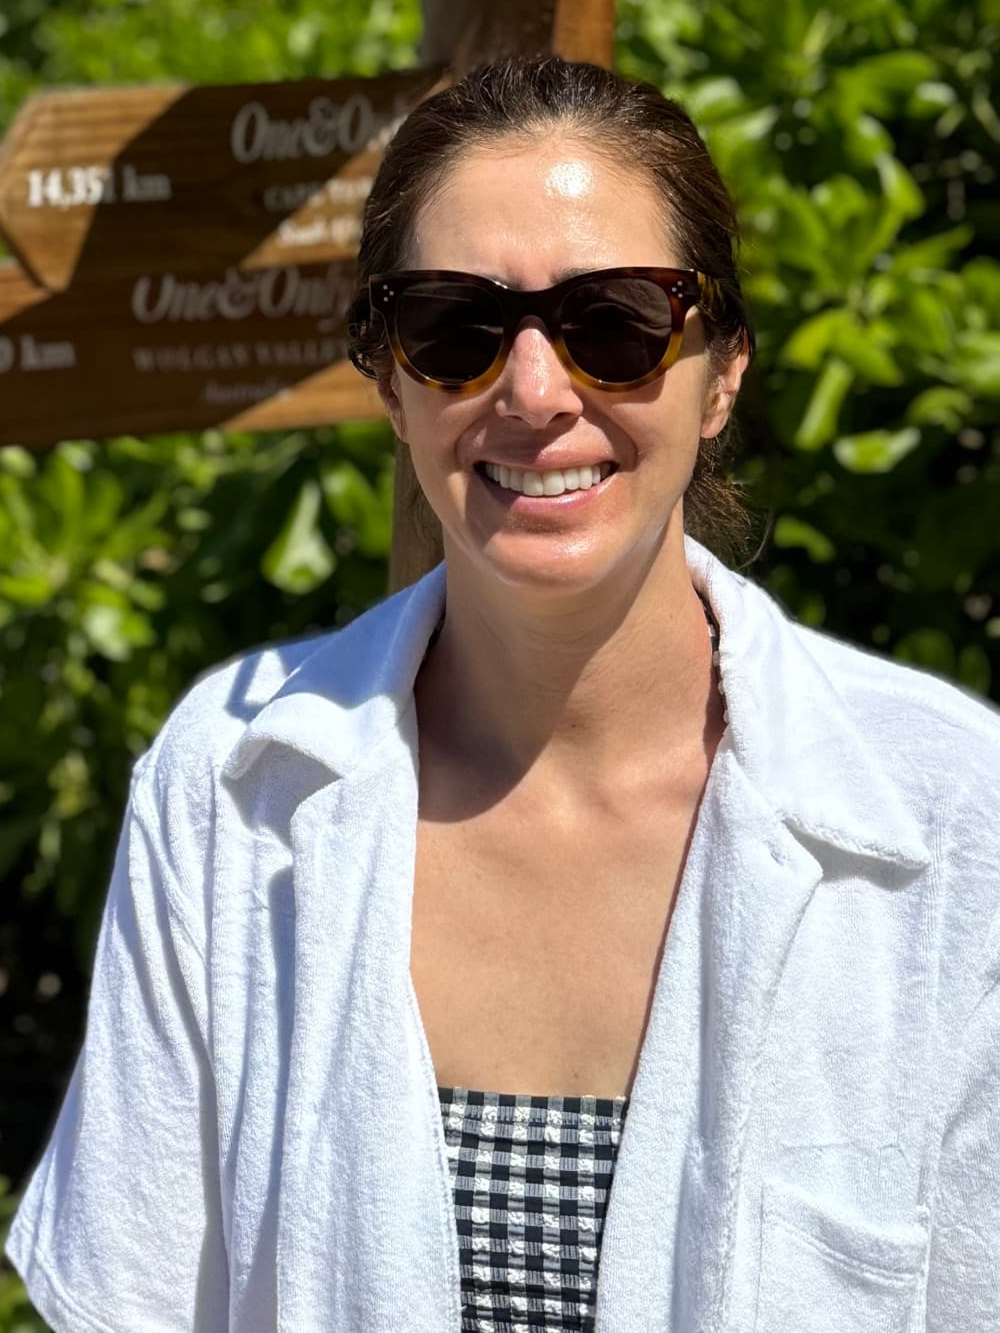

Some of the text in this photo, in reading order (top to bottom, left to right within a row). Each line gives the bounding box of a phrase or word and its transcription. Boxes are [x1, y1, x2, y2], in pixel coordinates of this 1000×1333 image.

[121, 163, 172, 204] km
[132, 264, 356, 334] One&Only
[19, 332, 77, 371] km
